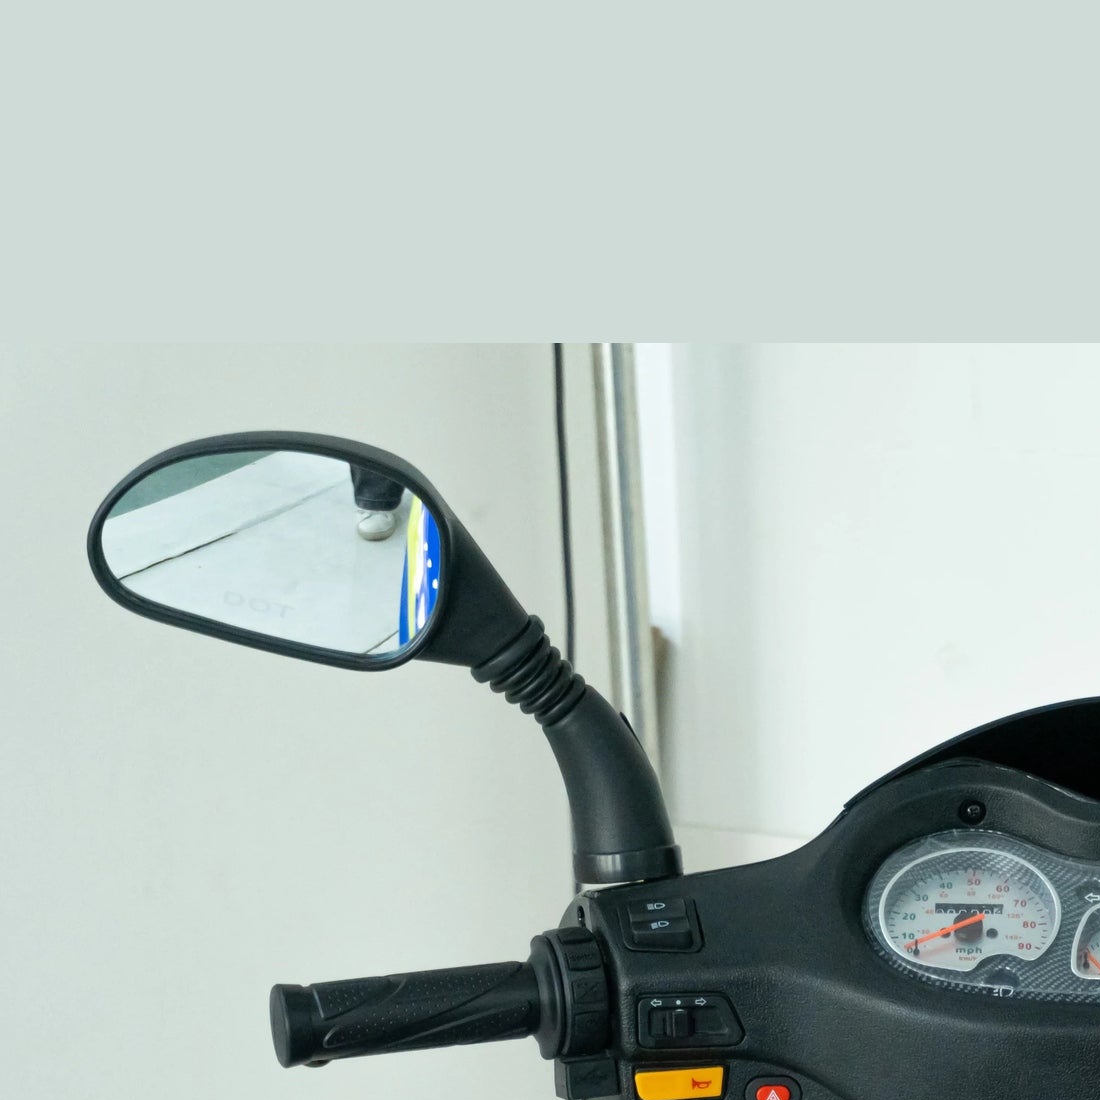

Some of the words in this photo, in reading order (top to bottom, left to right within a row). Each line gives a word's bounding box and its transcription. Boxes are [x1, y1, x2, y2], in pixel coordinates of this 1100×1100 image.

[939, 882, 953, 890] 40
[967, 878, 981, 886] 50
[995, 885, 1010, 893] 60
[914, 894, 929, 902] 30
[1013, 899, 1027, 908] 70
[902, 912, 916, 920] 20
[1022, 920, 1037, 929] 80
[901, 932, 915, 940] 10
[1017, 942, 1032, 950] 90
[955, 946, 982, 955] mph
